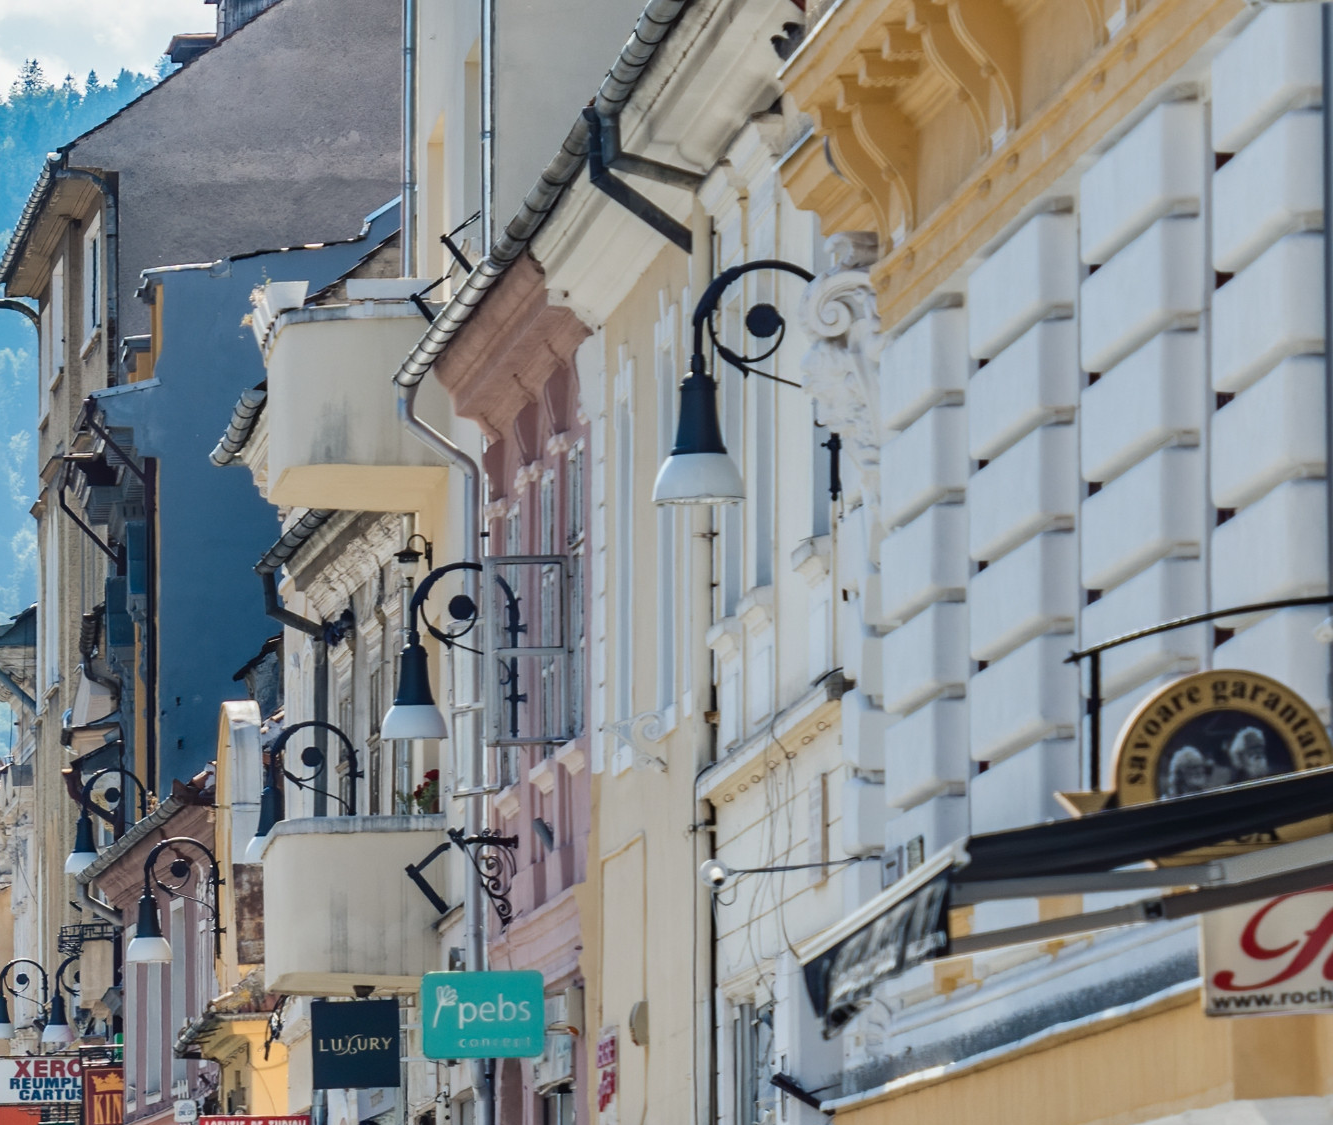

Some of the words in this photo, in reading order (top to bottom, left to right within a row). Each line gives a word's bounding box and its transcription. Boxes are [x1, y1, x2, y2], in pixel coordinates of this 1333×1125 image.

[1128, 685, 1201, 785] savoare
[458, 994, 531, 1029] pebs
[319, 1034, 393, 1056] LUXURY
